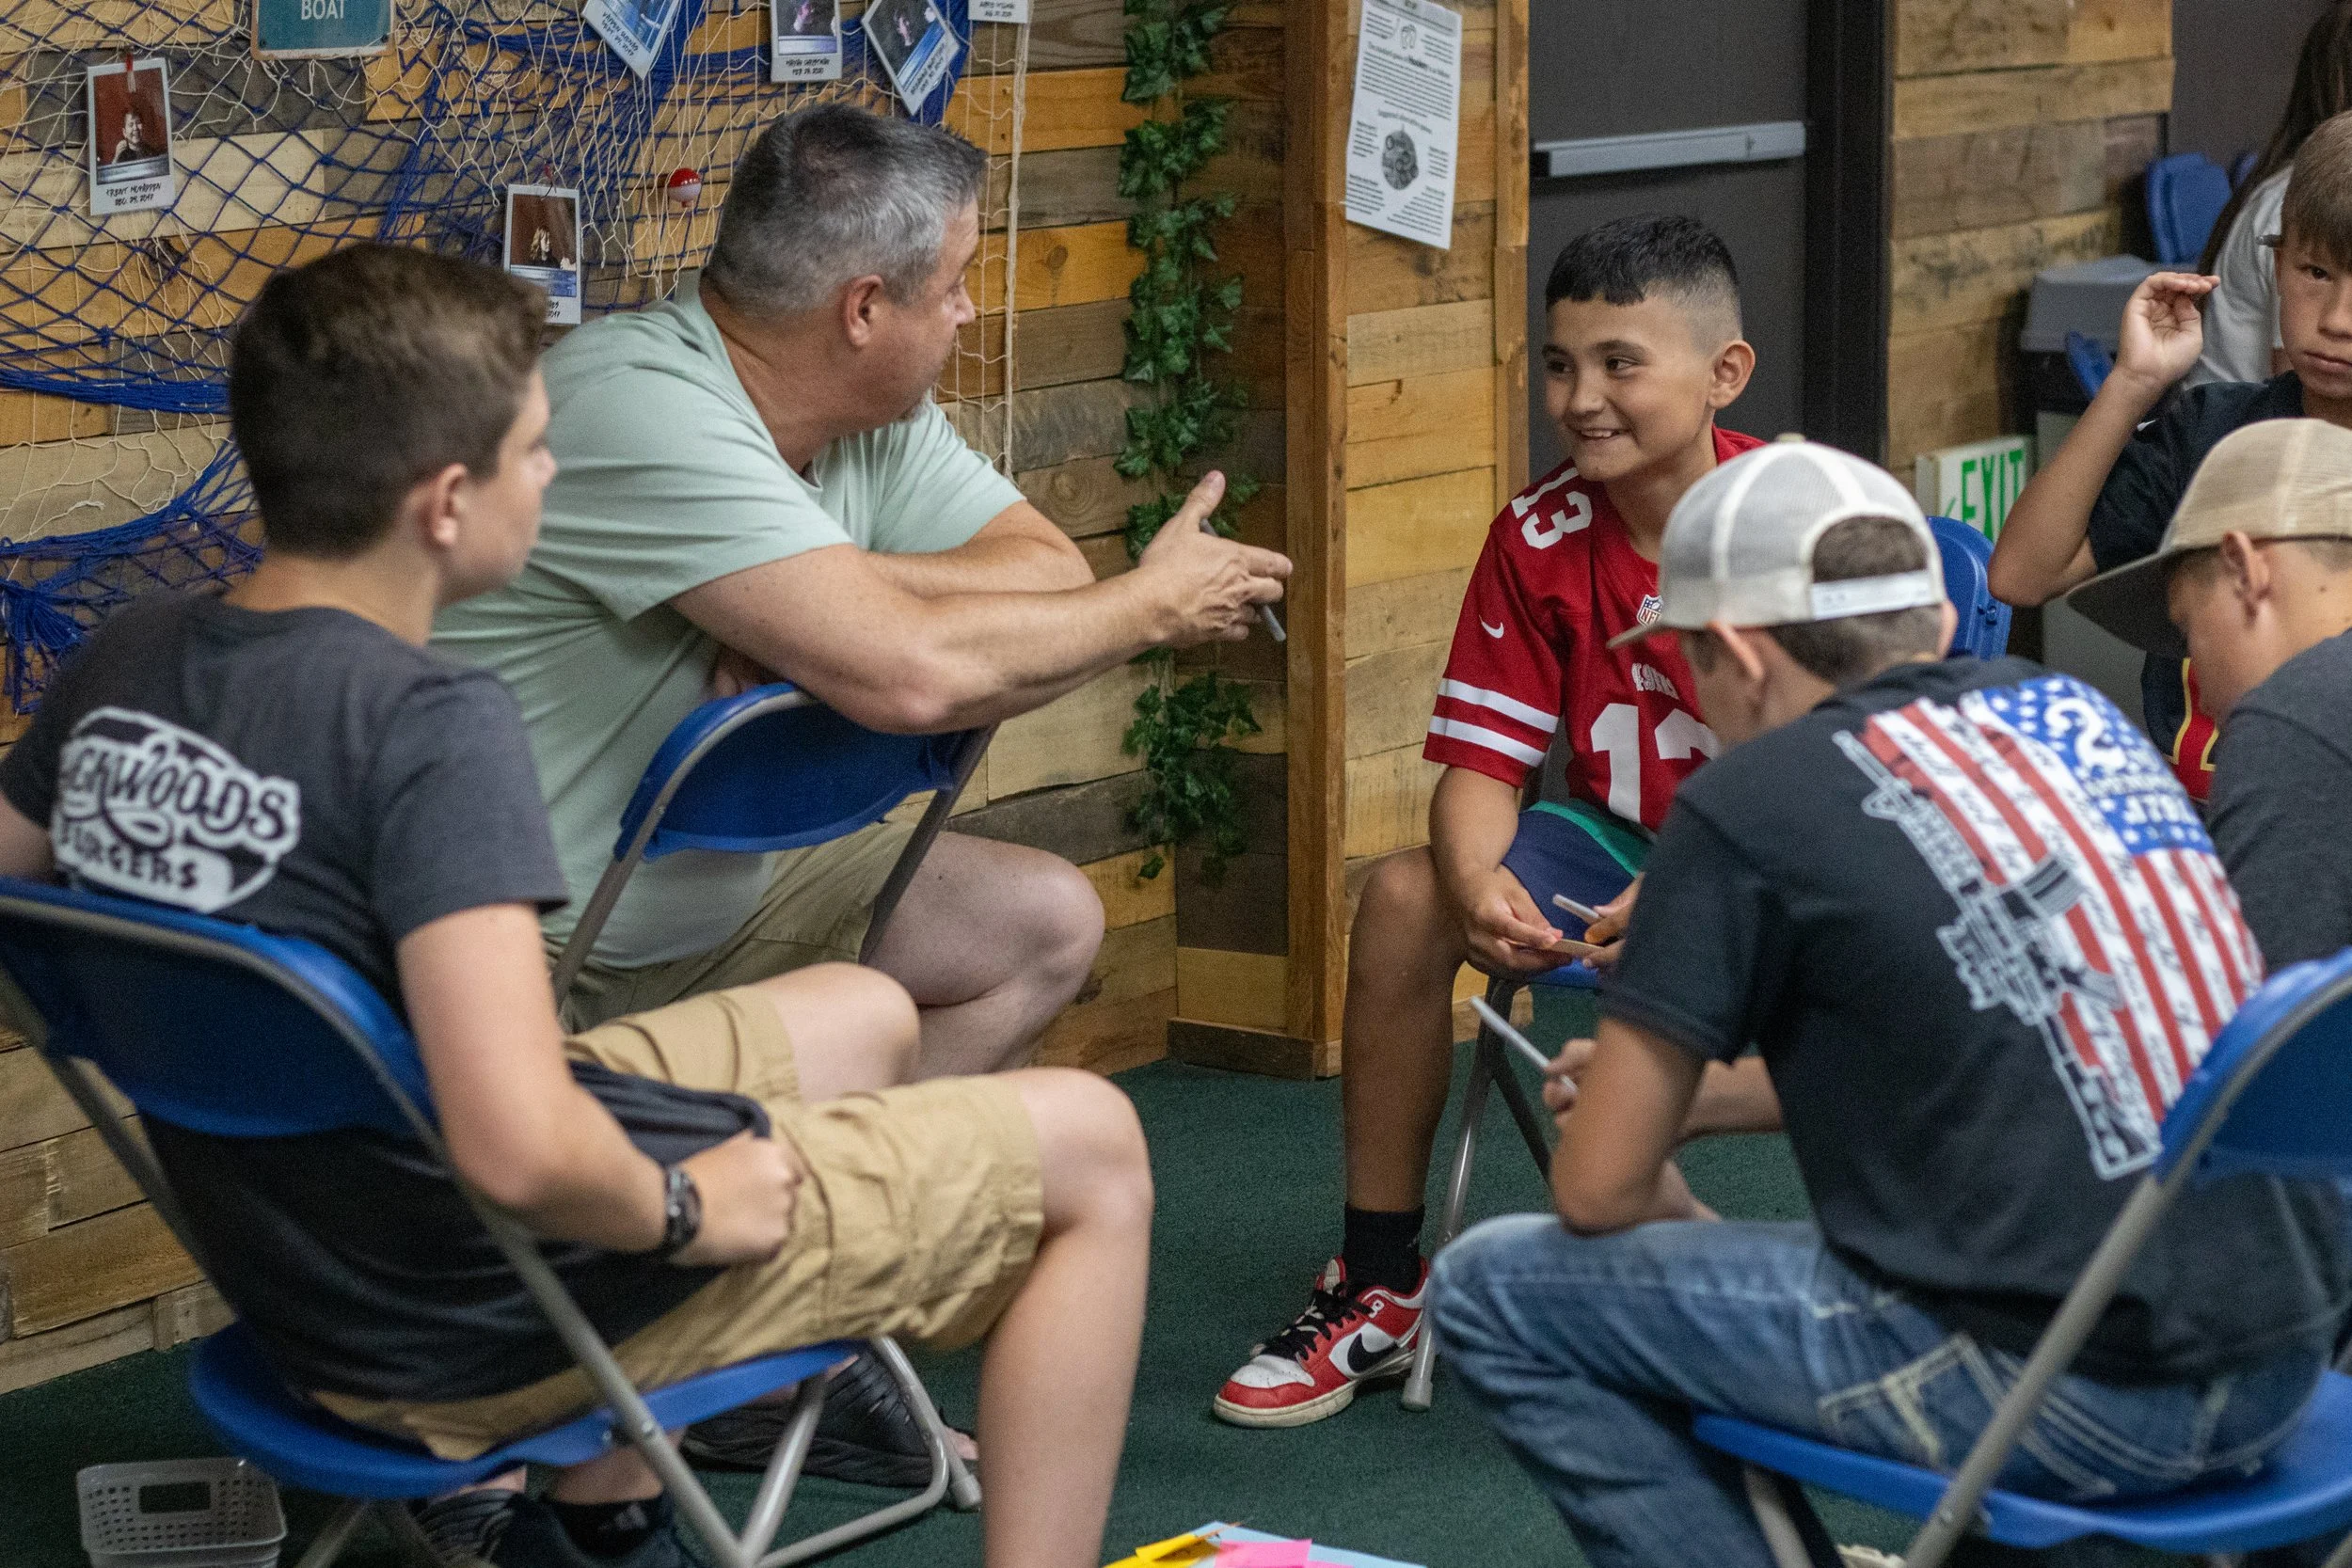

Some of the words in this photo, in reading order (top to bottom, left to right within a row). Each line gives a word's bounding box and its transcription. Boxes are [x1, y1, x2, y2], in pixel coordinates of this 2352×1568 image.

[301, 0, 344, 20] BOAT
[1511, 467, 1593, 549] 13
[1962, 449, 2024, 543] EXIT
